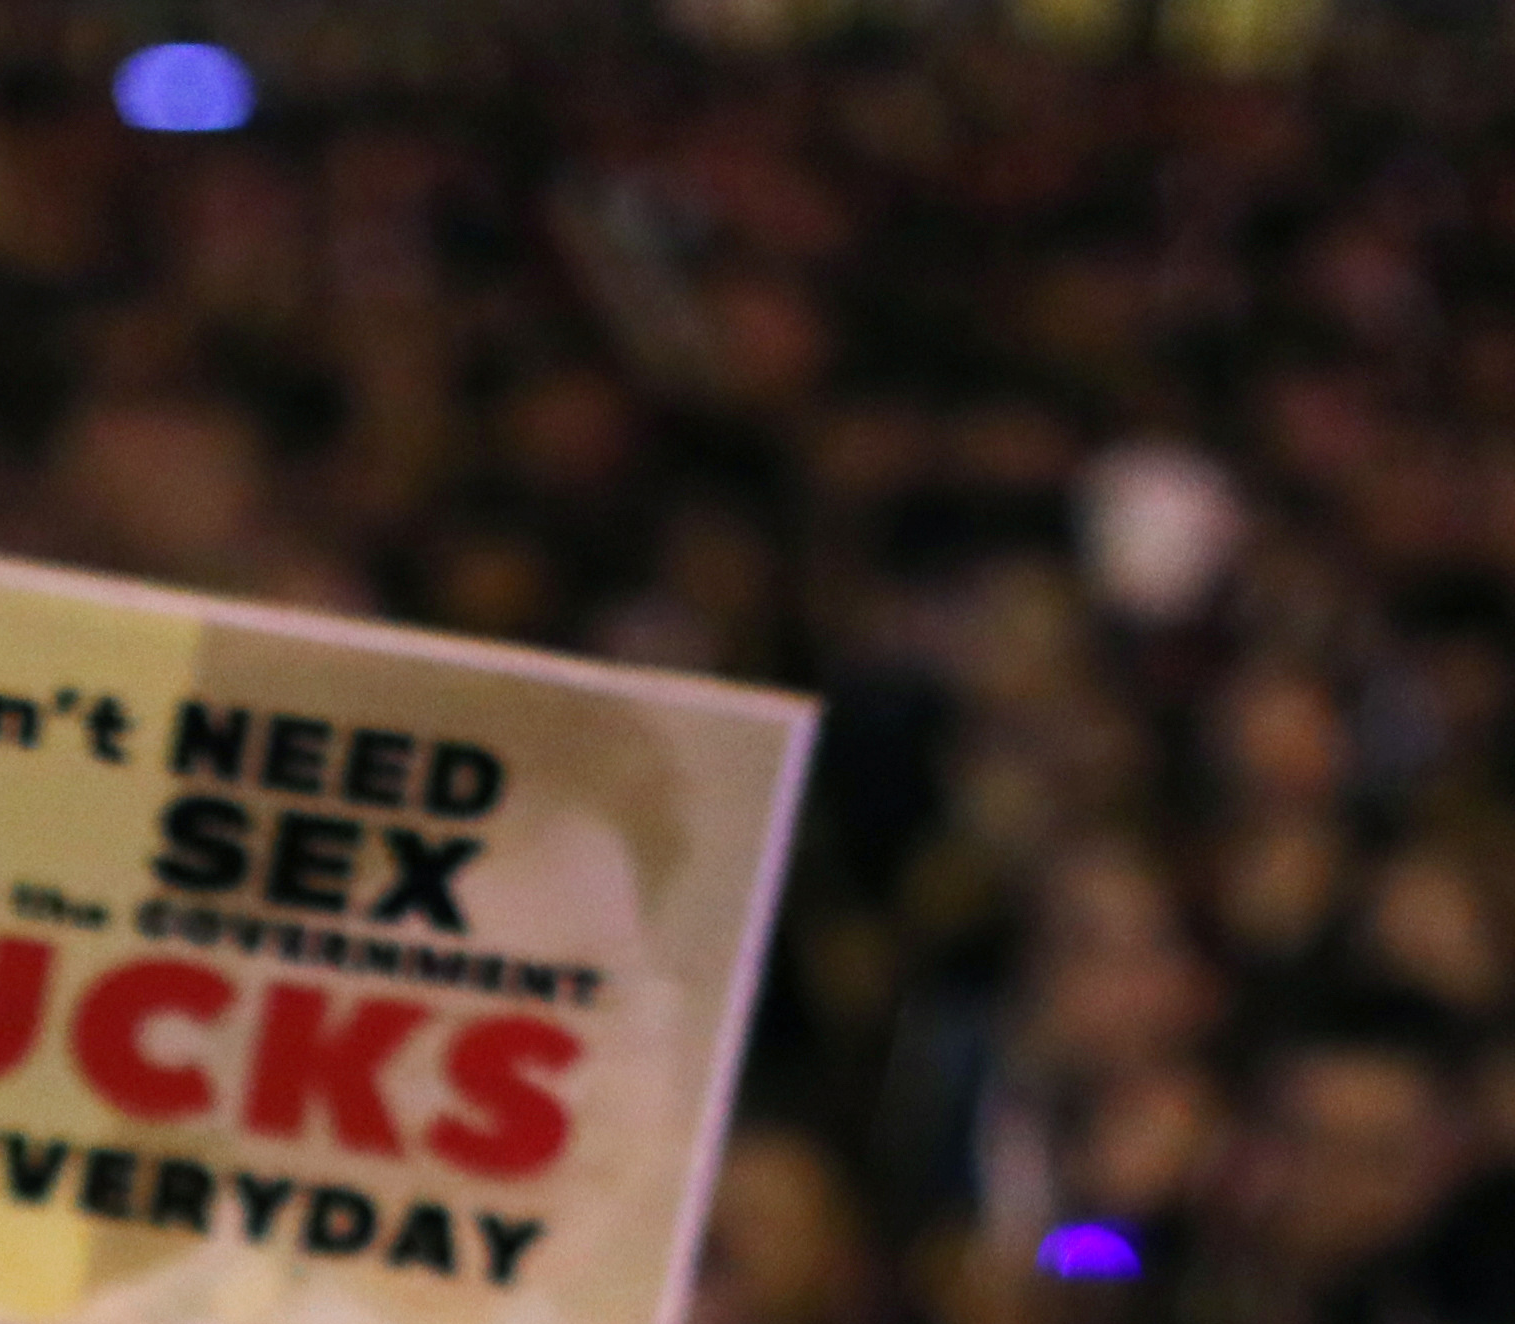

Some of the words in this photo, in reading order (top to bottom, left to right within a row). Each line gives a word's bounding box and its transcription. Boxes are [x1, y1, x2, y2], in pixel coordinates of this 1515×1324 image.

[169, 700, 508, 822] NEED
[151, 798, 482, 934] SEX
[16, 887, 106, 926] the
[136, 901, 608, 1006] GOVERNMENT
